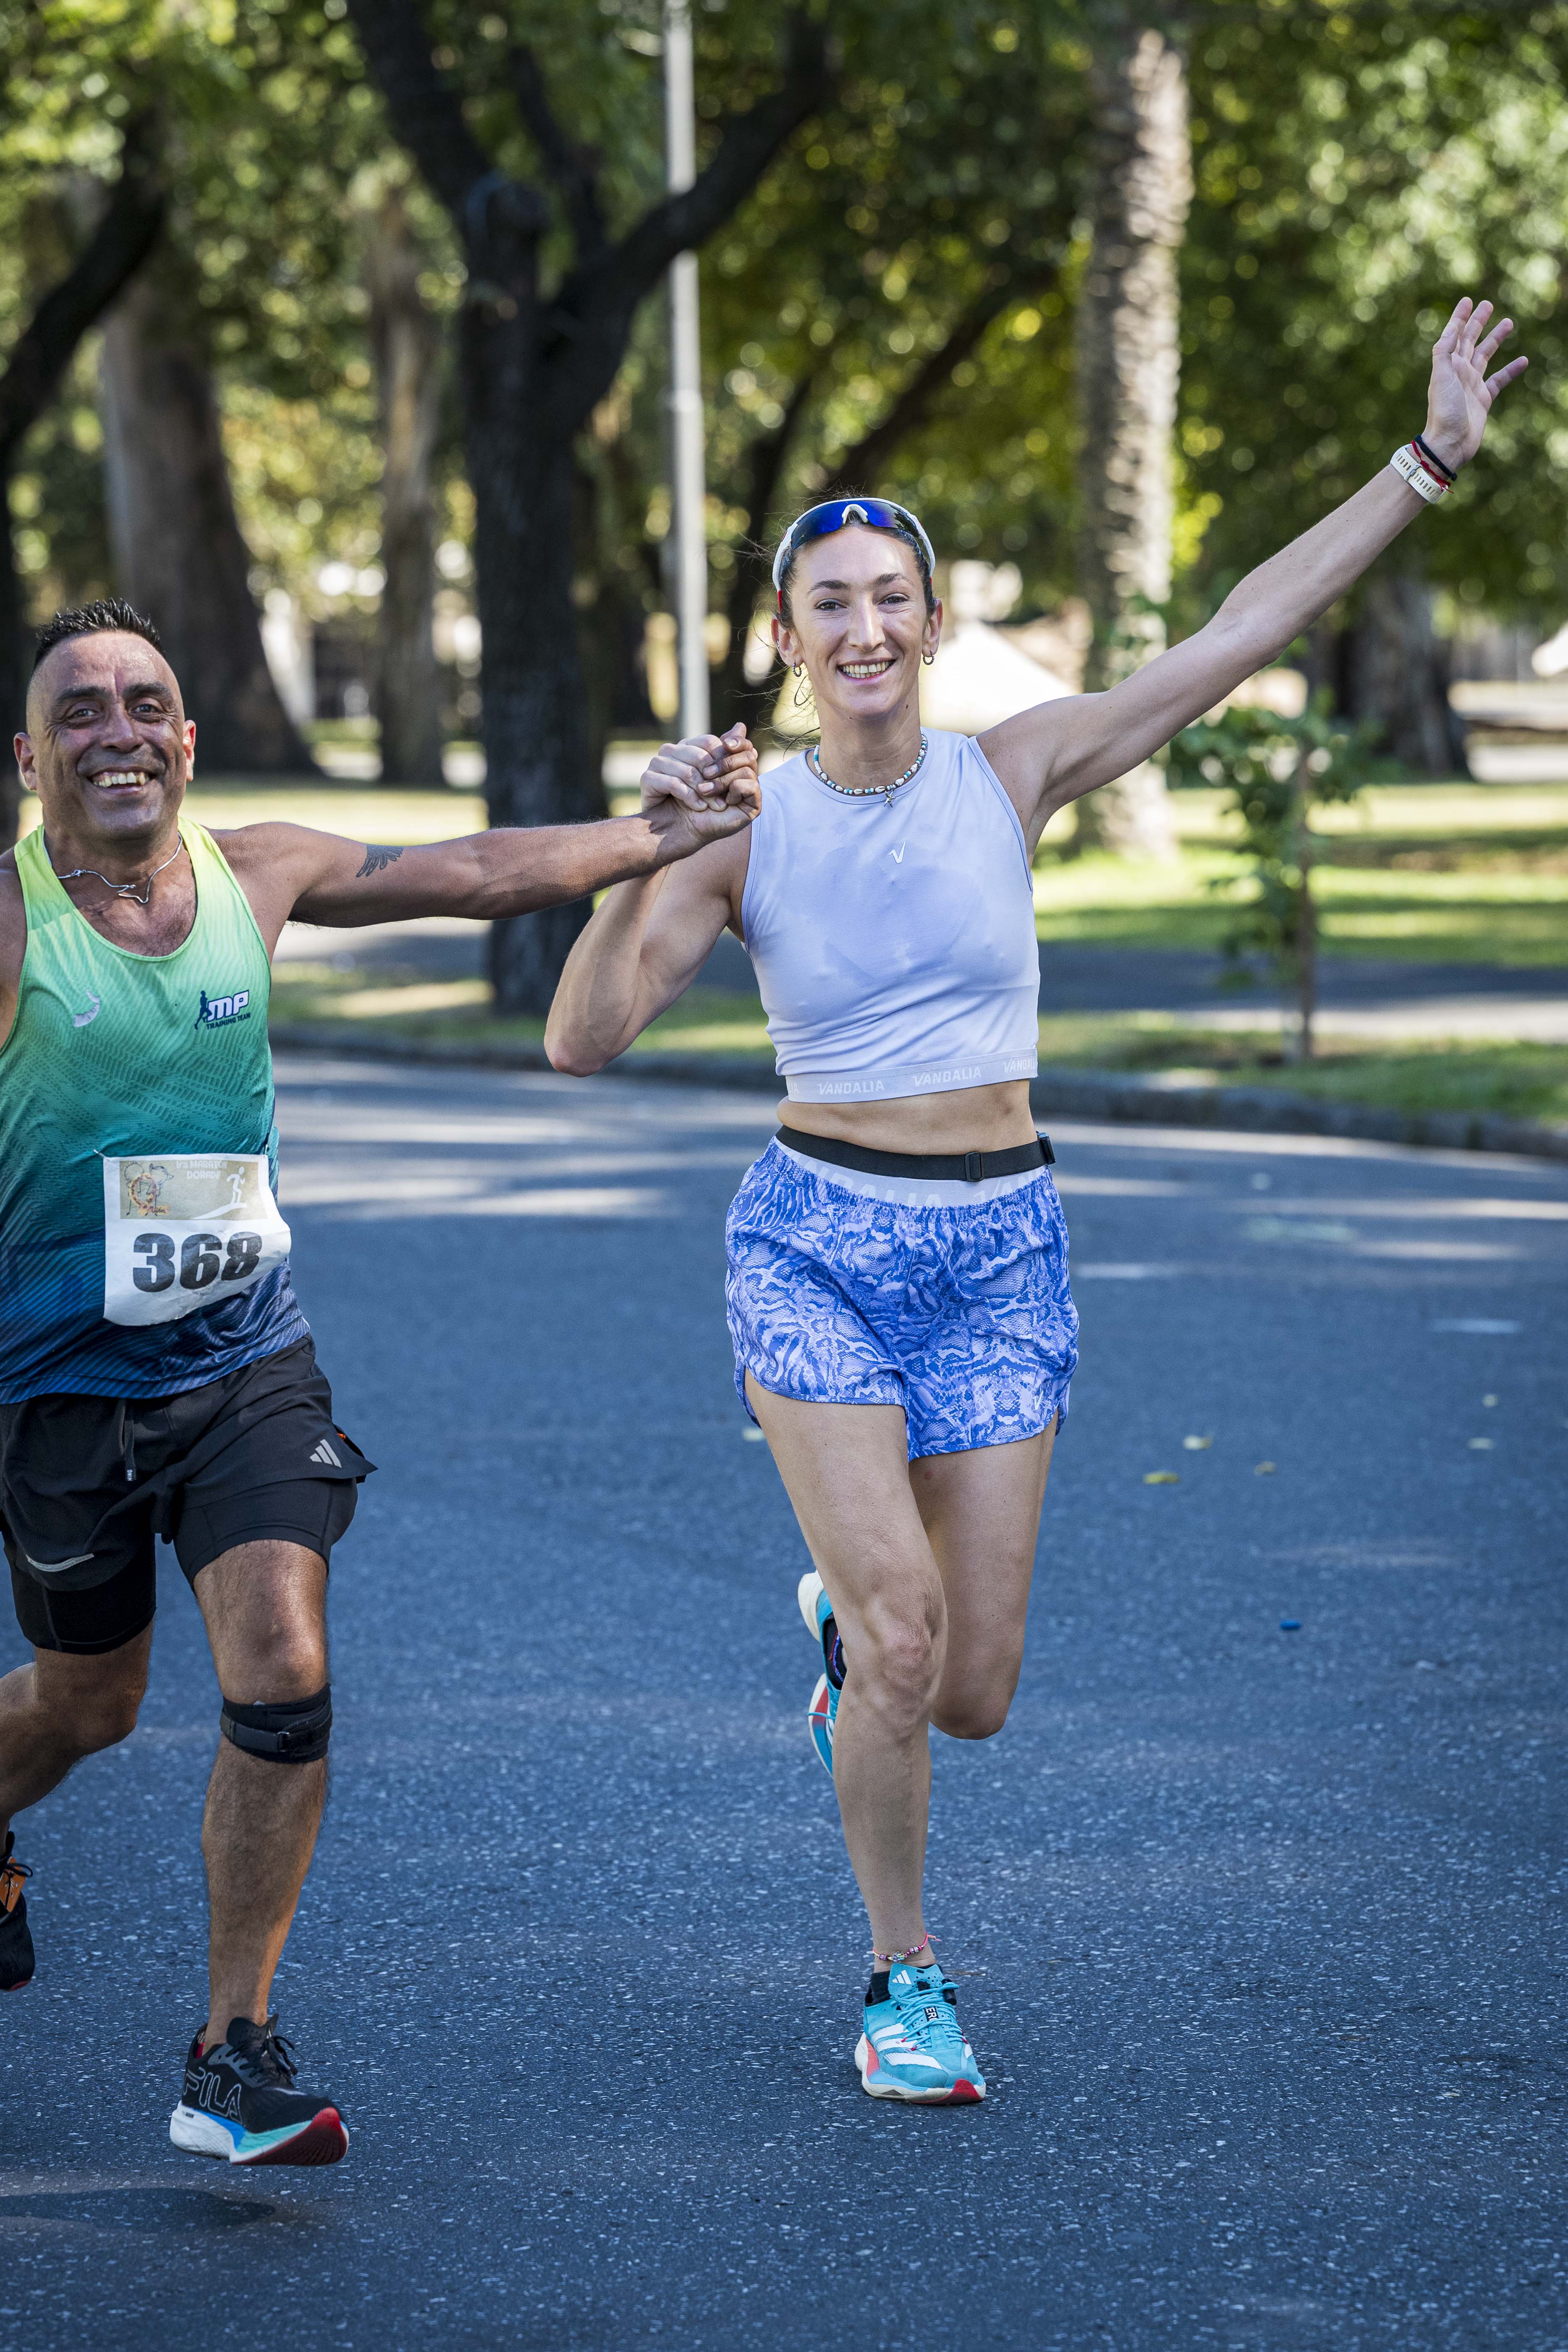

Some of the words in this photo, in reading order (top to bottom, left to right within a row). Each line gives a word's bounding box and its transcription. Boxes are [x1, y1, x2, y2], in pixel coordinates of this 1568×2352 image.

[206, 1018, 236, 1029] TRAINING
[238, 1012, 251, 1021] TEAM
[817, 1080, 885, 1095] VANDALIA
[912, 1066, 982, 1087] VANDALIA
[133, 1232, 262, 1293] 368
[183, 2066, 243, 2124] FILA
